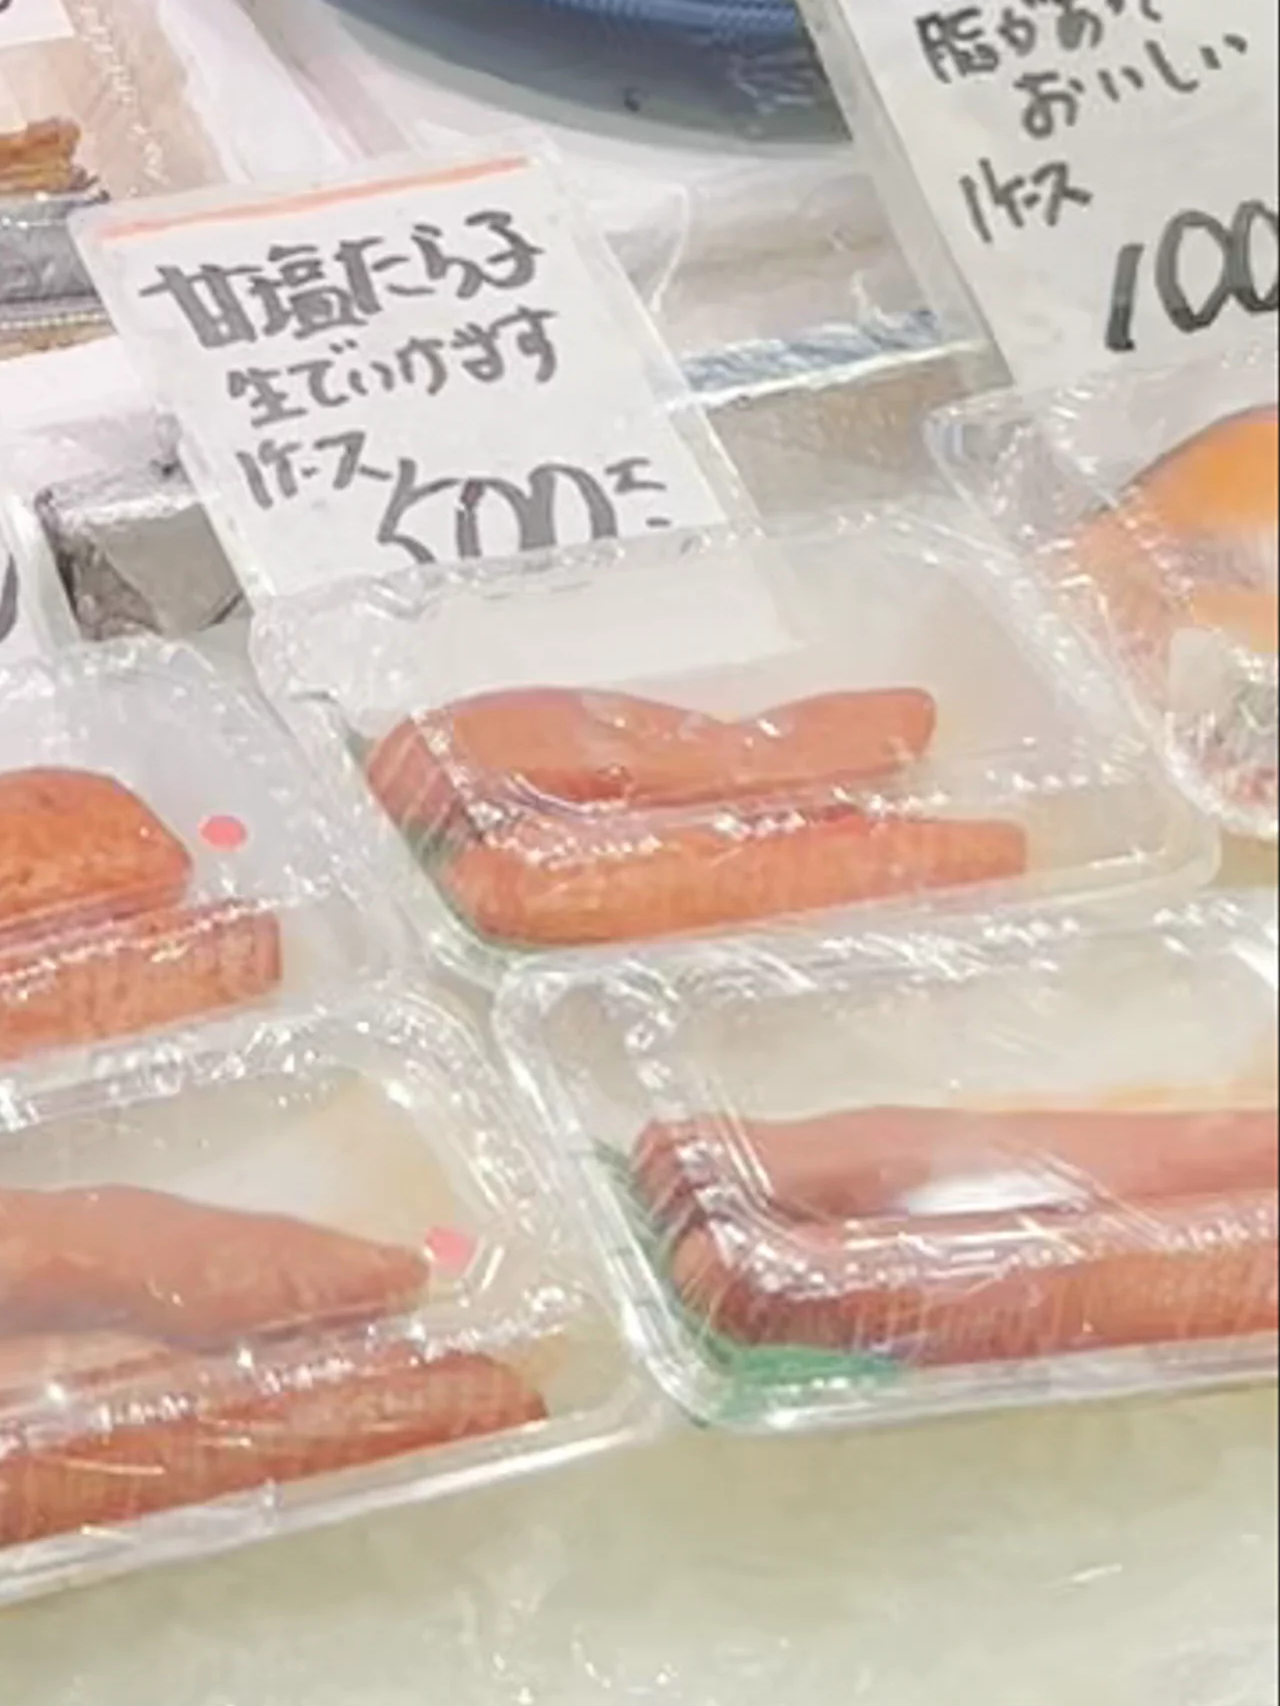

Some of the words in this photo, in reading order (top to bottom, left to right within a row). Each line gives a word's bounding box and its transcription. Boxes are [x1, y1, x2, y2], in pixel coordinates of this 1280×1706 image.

[1012, 33, 1249, 140] おいしい
[140, 209, 544, 349] 甘塩たら子
[226, 304, 559, 429] 生でいけます
